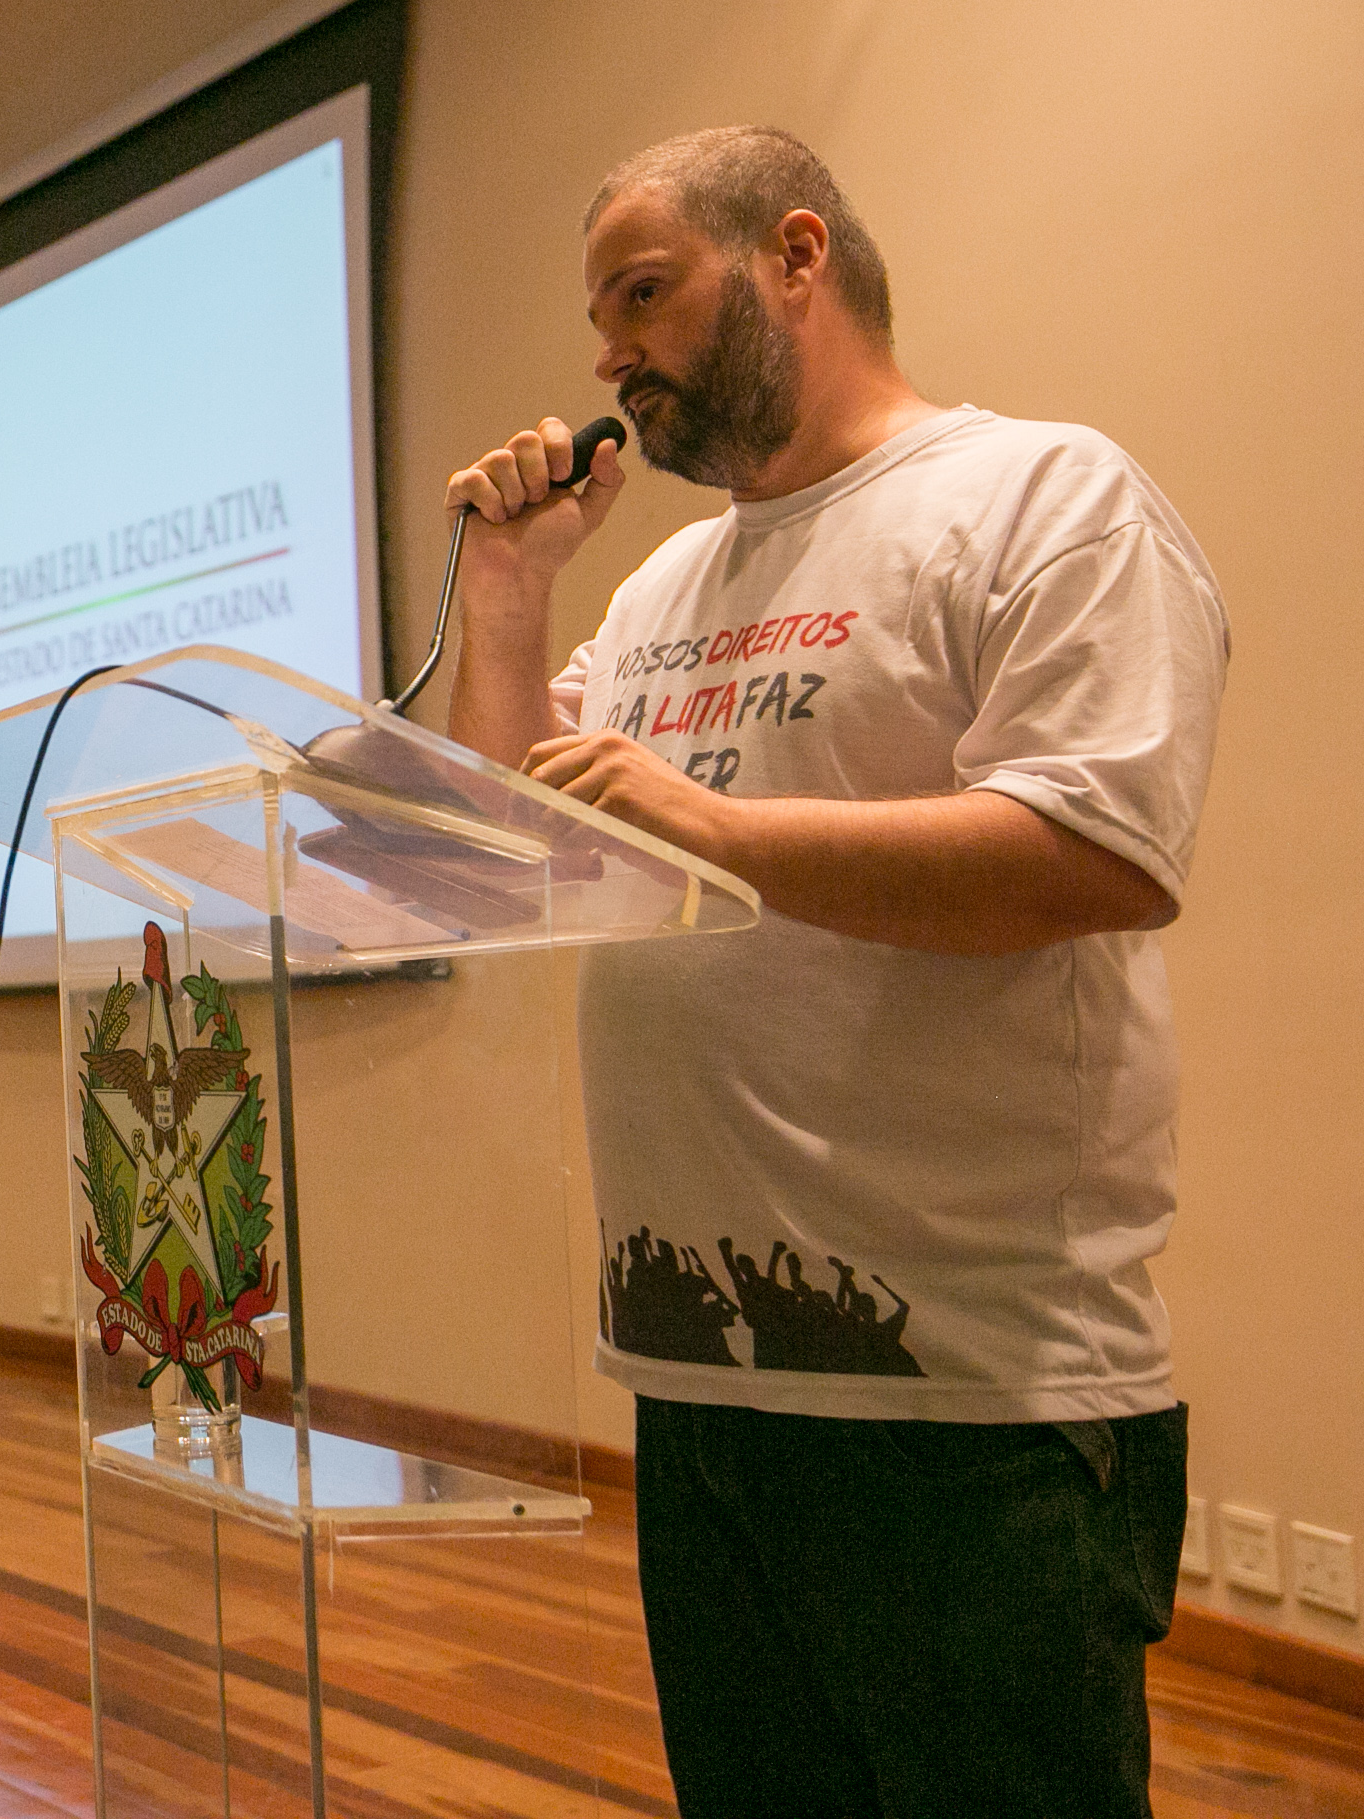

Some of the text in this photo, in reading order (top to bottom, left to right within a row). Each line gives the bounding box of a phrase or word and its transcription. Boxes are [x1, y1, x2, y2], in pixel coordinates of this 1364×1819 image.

[108, 480, 290, 578] LEGISLATIVA
[69, 626, 97, 669] DE
[100, 609, 169, 659] SANTA
[172, 577, 294, 640] CATARINA
[705, 610, 860, 665] DIREITOS
[622, 693, 647, 741] A
[649, 680, 737, 737] LUTA
[736, 671, 827, 728] FAZ
[101, 1302, 147, 1339] ESTADO
[146, 1327, 163, 1353] DE
